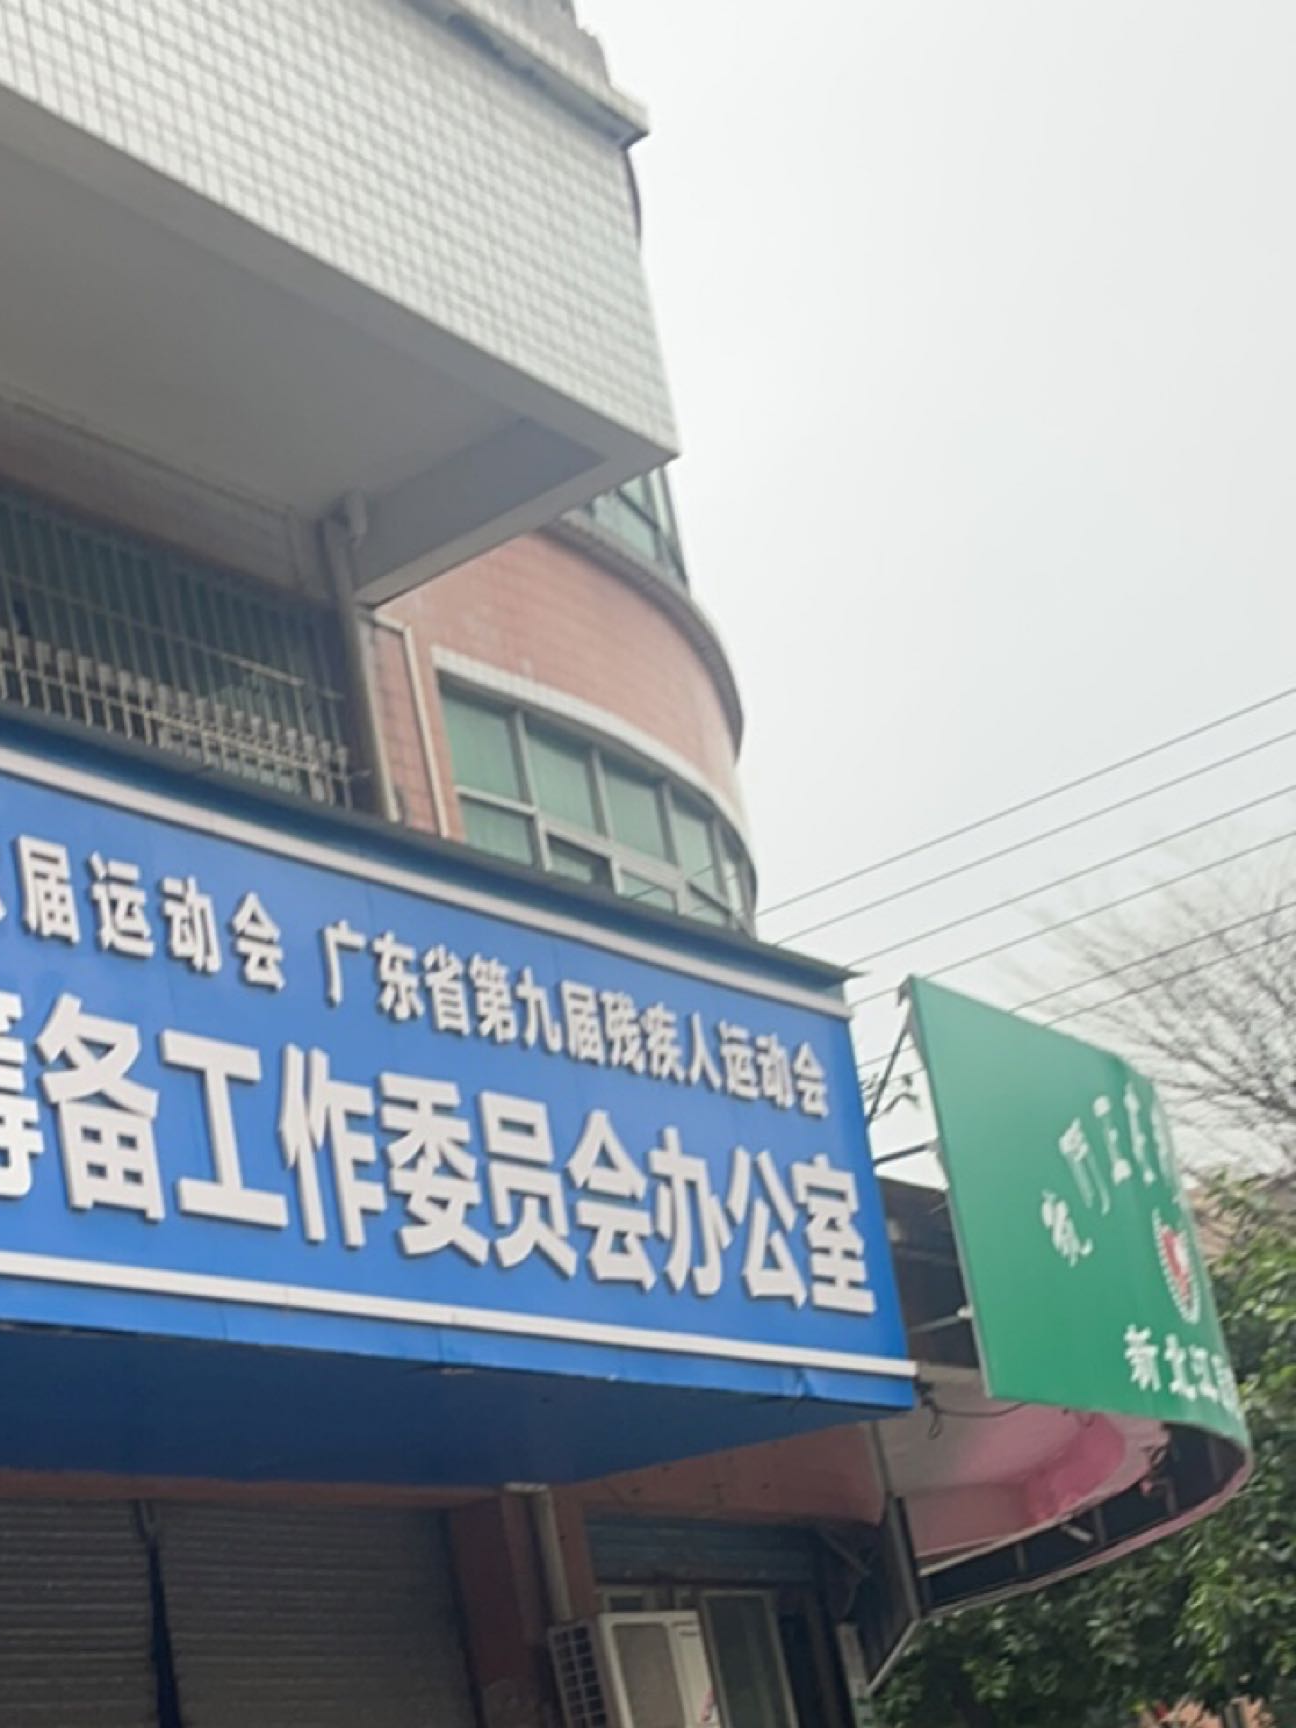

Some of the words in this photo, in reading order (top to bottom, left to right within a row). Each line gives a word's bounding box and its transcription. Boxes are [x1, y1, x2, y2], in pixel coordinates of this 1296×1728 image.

[322, 919, 831, 1121] 广东省第九届残疾人运动会
